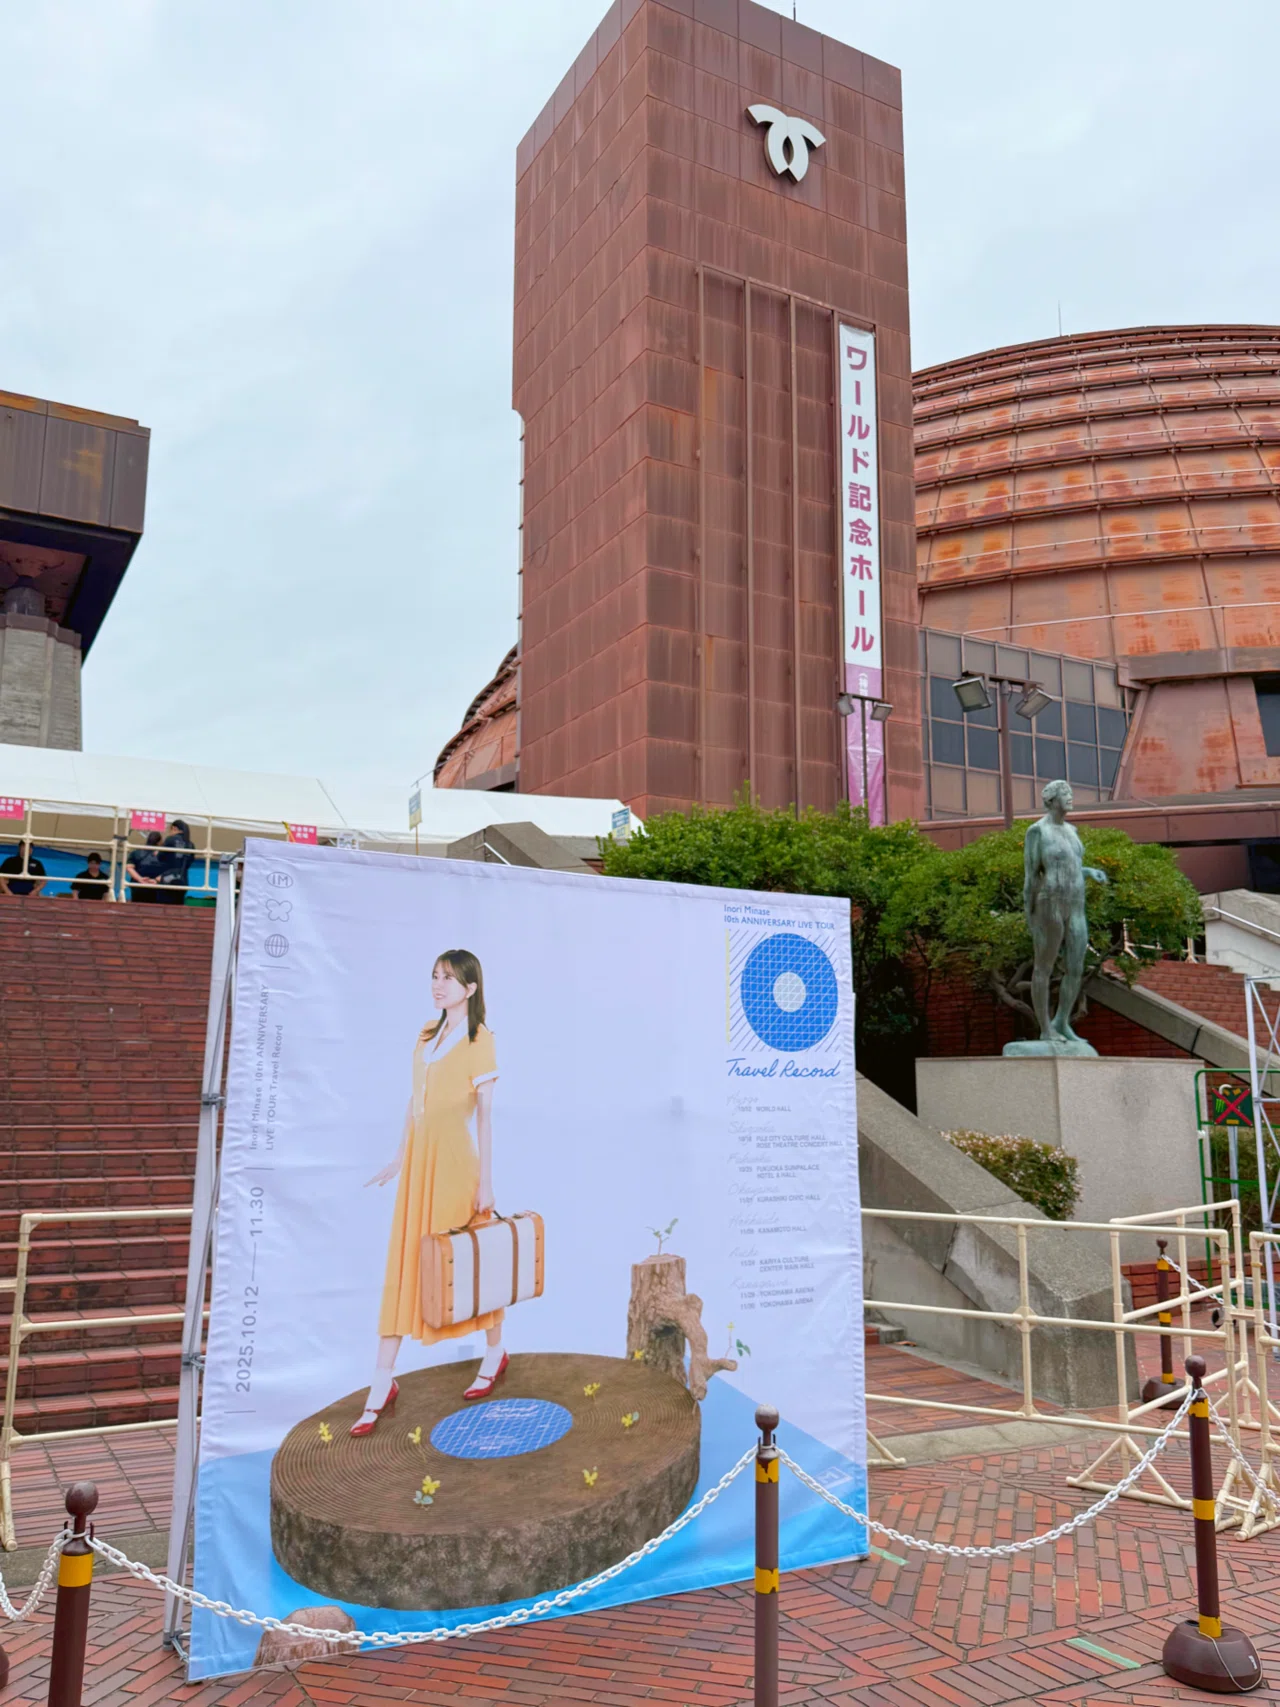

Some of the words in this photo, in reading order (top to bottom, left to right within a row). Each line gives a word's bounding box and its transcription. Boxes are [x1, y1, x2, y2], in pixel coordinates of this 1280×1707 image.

[846, 345, 875, 652] ワールド記念ホール
[724, 904, 743, 914] Inori
[744, 905, 771, 916] Minase
[724, 915, 740, 924] 10th
[741, 916, 796, 928] ANNIVERSARY
[798, 920, 813, 929] LIVE
[815, 921, 835, 930] TOUR
[256, 984, 270, 1057] ANNIVERSARY
[273, 1025, 283, 1058] Record
[255, 1059, 264, 1083] 10th
[269, 1060, 279, 1092] Travel
[726, 1058, 780, 1078] Travel
[779, 1059, 842, 1078] Record
[252, 1086, 262, 1122] Minase
[266, 1095, 277, 1124] TOUR
[248, 1123, 258, 1151] Inori
[265, 1126, 275, 1151] LIVE
[758, 1226, 790, 1234] KANAMOTO
[782, 1256, 809, 1264] CULTURE
[759, 1289, 793, 1297] YOKOHAMA
[794, 1287, 815, 1295] ARENA
[759, 1300, 793, 1308] YOKOHAMA
[794, 1297, 814, 1305] ARENA
